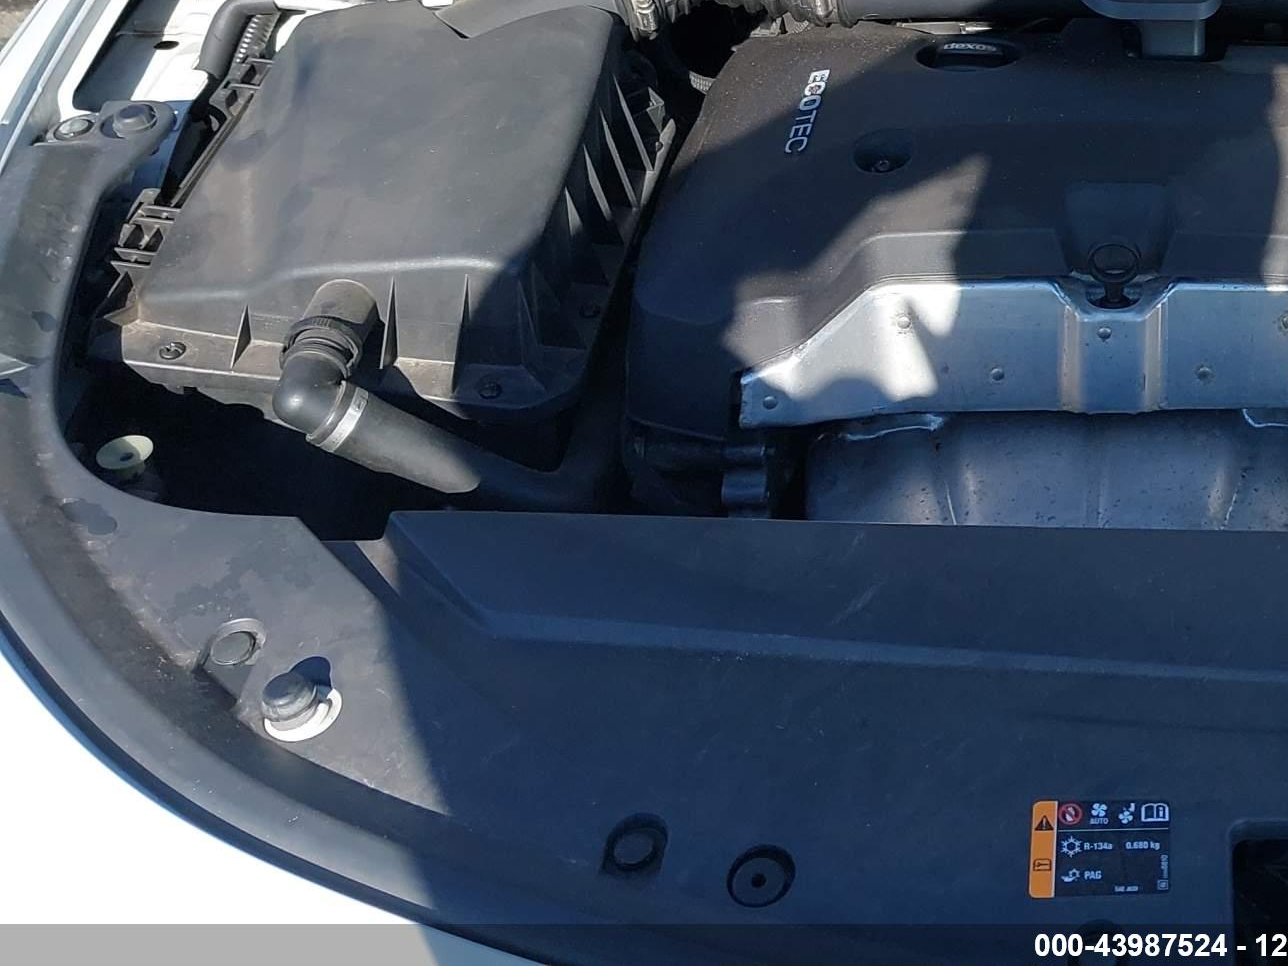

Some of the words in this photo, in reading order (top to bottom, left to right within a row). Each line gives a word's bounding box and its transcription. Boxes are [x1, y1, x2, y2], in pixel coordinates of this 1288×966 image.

[784, 69, 830, 153] ECOTEC
[1090, 817, 1109, 825] AUTO
[1083, 841, 1113, 851] R-134a
[1150, 841, 1161, 852] kg
[1083, 870, 1103, 880] PAG
